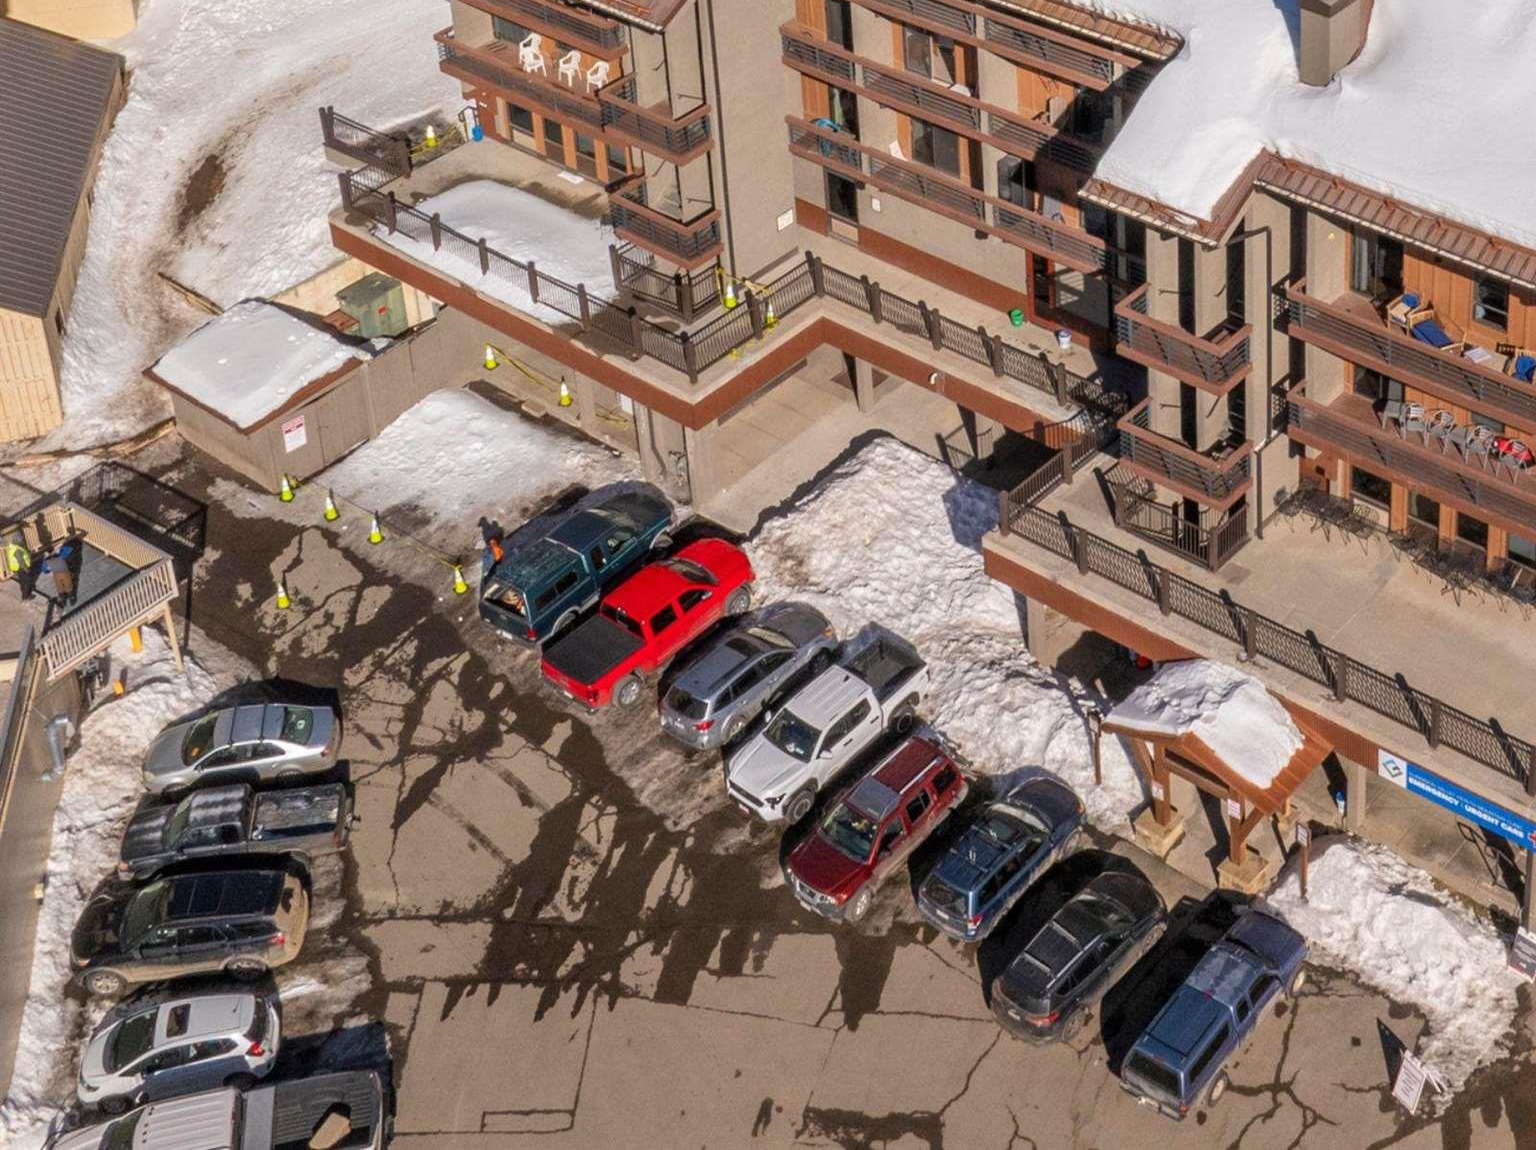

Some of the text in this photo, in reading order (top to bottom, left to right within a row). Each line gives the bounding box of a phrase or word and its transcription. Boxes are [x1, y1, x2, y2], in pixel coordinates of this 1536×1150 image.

[1408, 776, 1460, 806] EMERGENCY
[1464, 803, 1500, 826] URGENT
[1500, 822, 1525, 839] CARE
